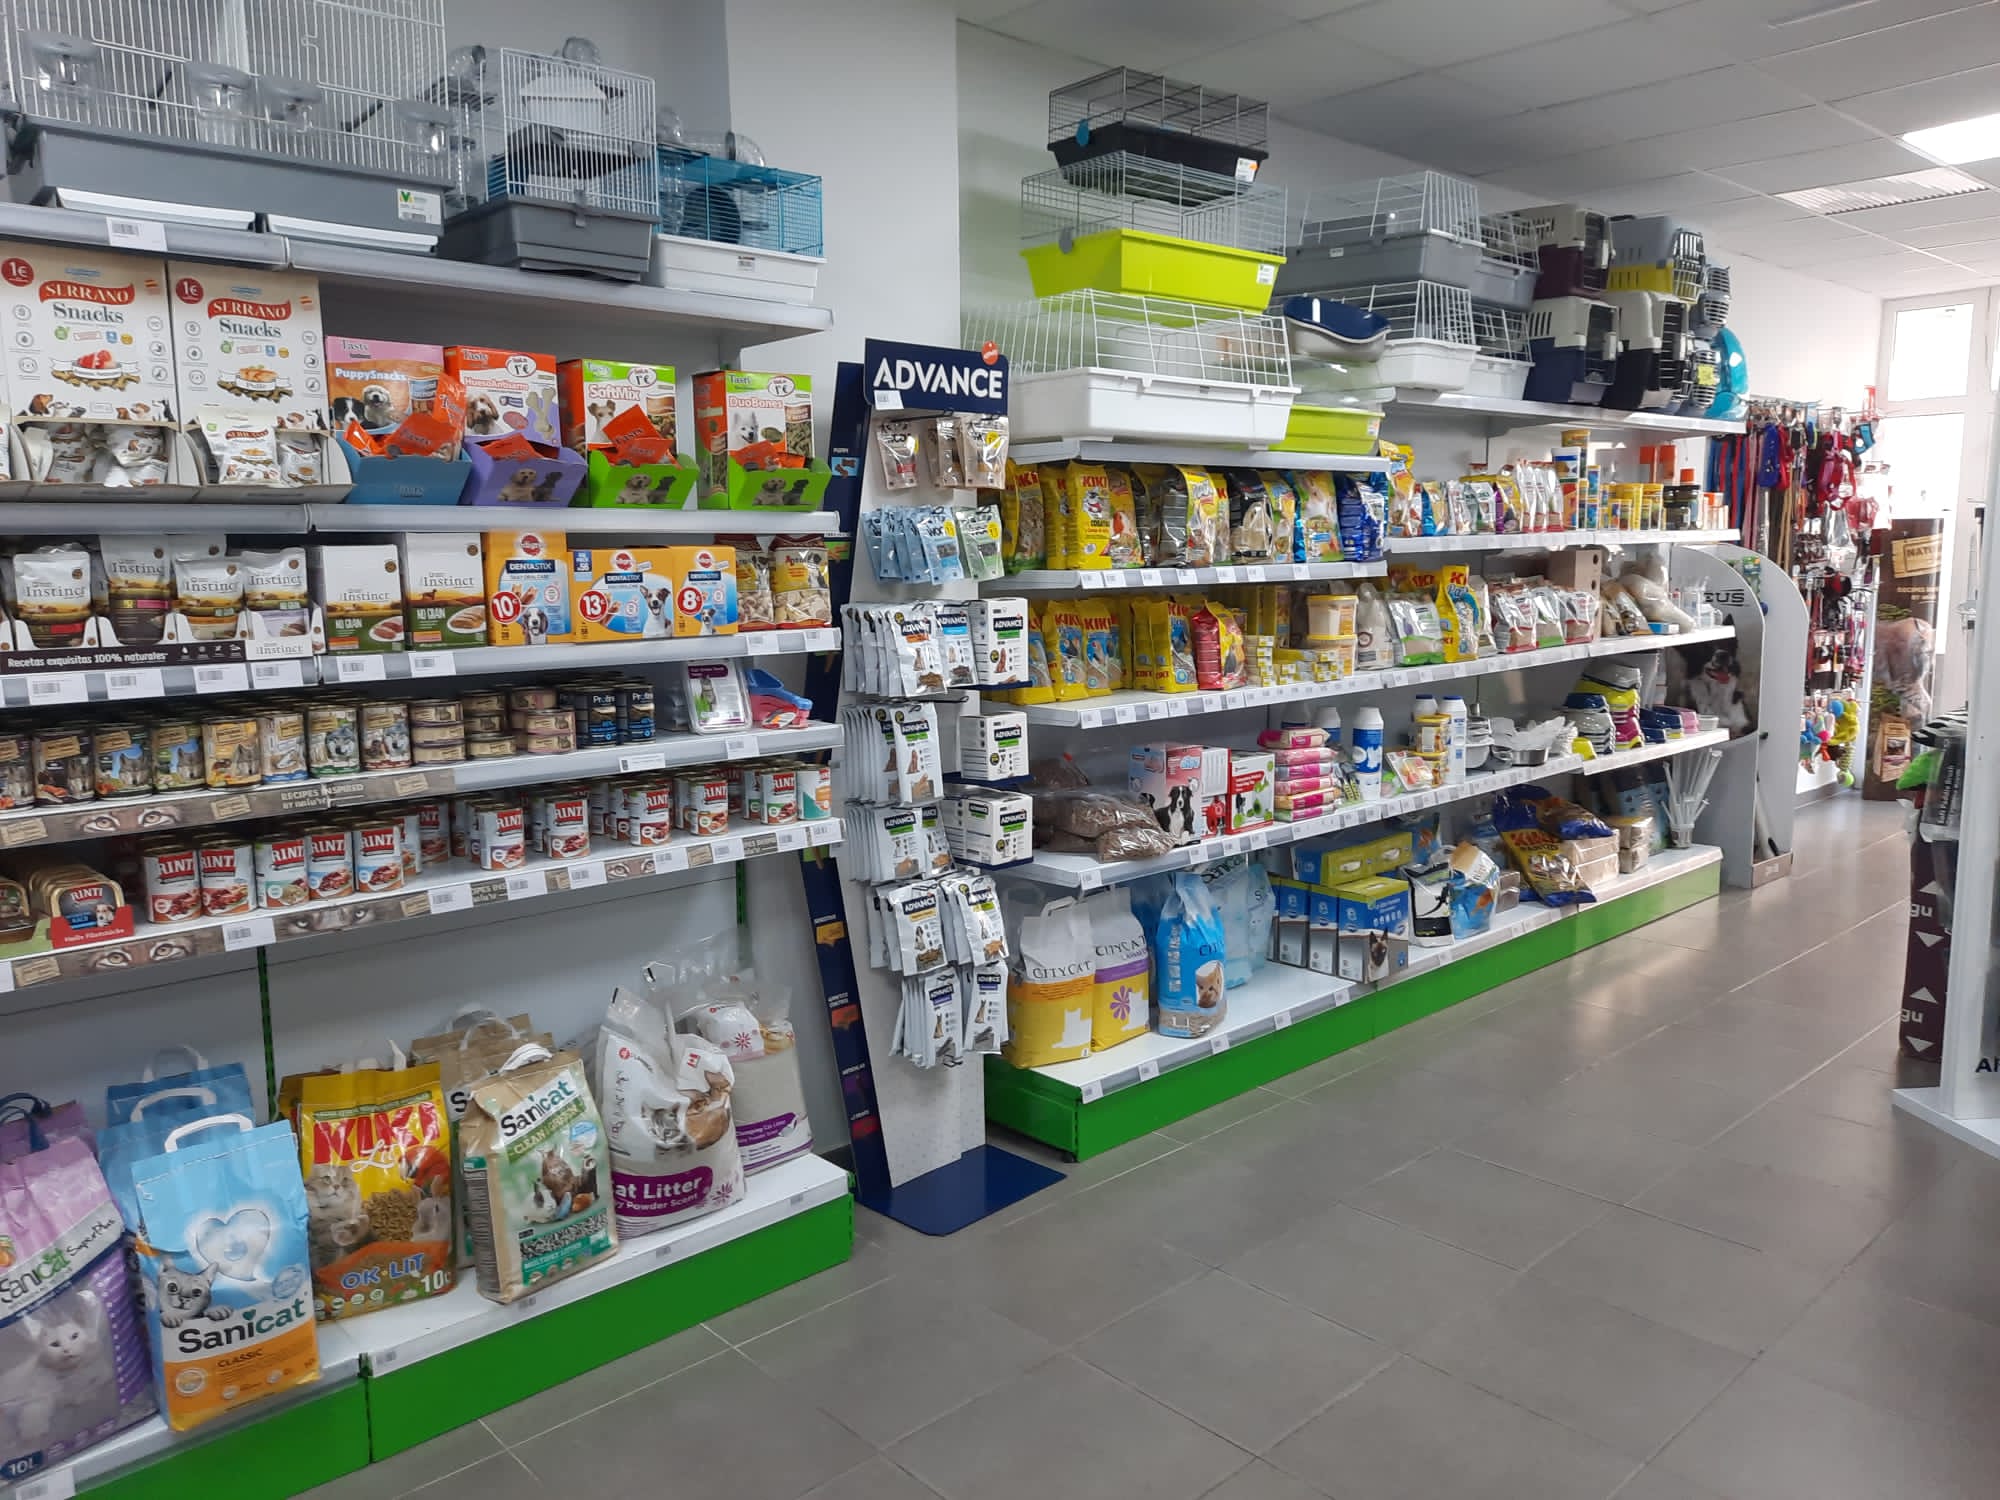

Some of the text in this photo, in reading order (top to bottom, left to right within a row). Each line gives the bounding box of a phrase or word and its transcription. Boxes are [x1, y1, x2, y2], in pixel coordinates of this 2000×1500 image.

[46, 283, 129, 304] SERRANO
[53, 302, 124, 324] Snacks
[214, 303, 286, 318] SERRANO
[220, 318, 282, 338] Snacks
[335, 368, 407, 382] PuppySnacks
[873, 357, 1003, 399] ADVANCE
[1082, 476, 1108, 488] KIKI
[112, 562, 165, 576] Instinc
[250, 574, 302, 586] Instinct
[424, 576, 474, 587] Instinct
[26, 585, 85, 598] Instinct
[185, 582, 238, 593] Instinct
[343, 592, 390, 602] Instinct
[994, 618, 1023, 629] ADVANCE
[259, 644, 302, 655] Instinct
[8, 657, 44, 668] Recetas
[46, 655, 92, 668] exquisitas
[94, 654, 122, 664] 100%
[280, 788, 319, 801] RECIPES
[885, 814, 915, 828] ADVANCE
[1000, 814, 1026, 825] ADVANCE
[70, 888, 103, 902] RINTI
[904, 898, 936, 914] ADVANCE
[1096, 935, 1146, 956] CITYCAT
[1032, 960, 1090, 980] CITYCAT
[500, 1080, 574, 1138] Sanicat
[313, 1103, 441, 1164] KIKI
[615, 1177, 703, 1200] at Litter
[626, 1201, 668, 1210] Powder
[670, 1193, 698, 1207] Scent
[178, 1298, 307, 1354] Sanicat
[216, 1347, 262, 1368] CLASSIC
